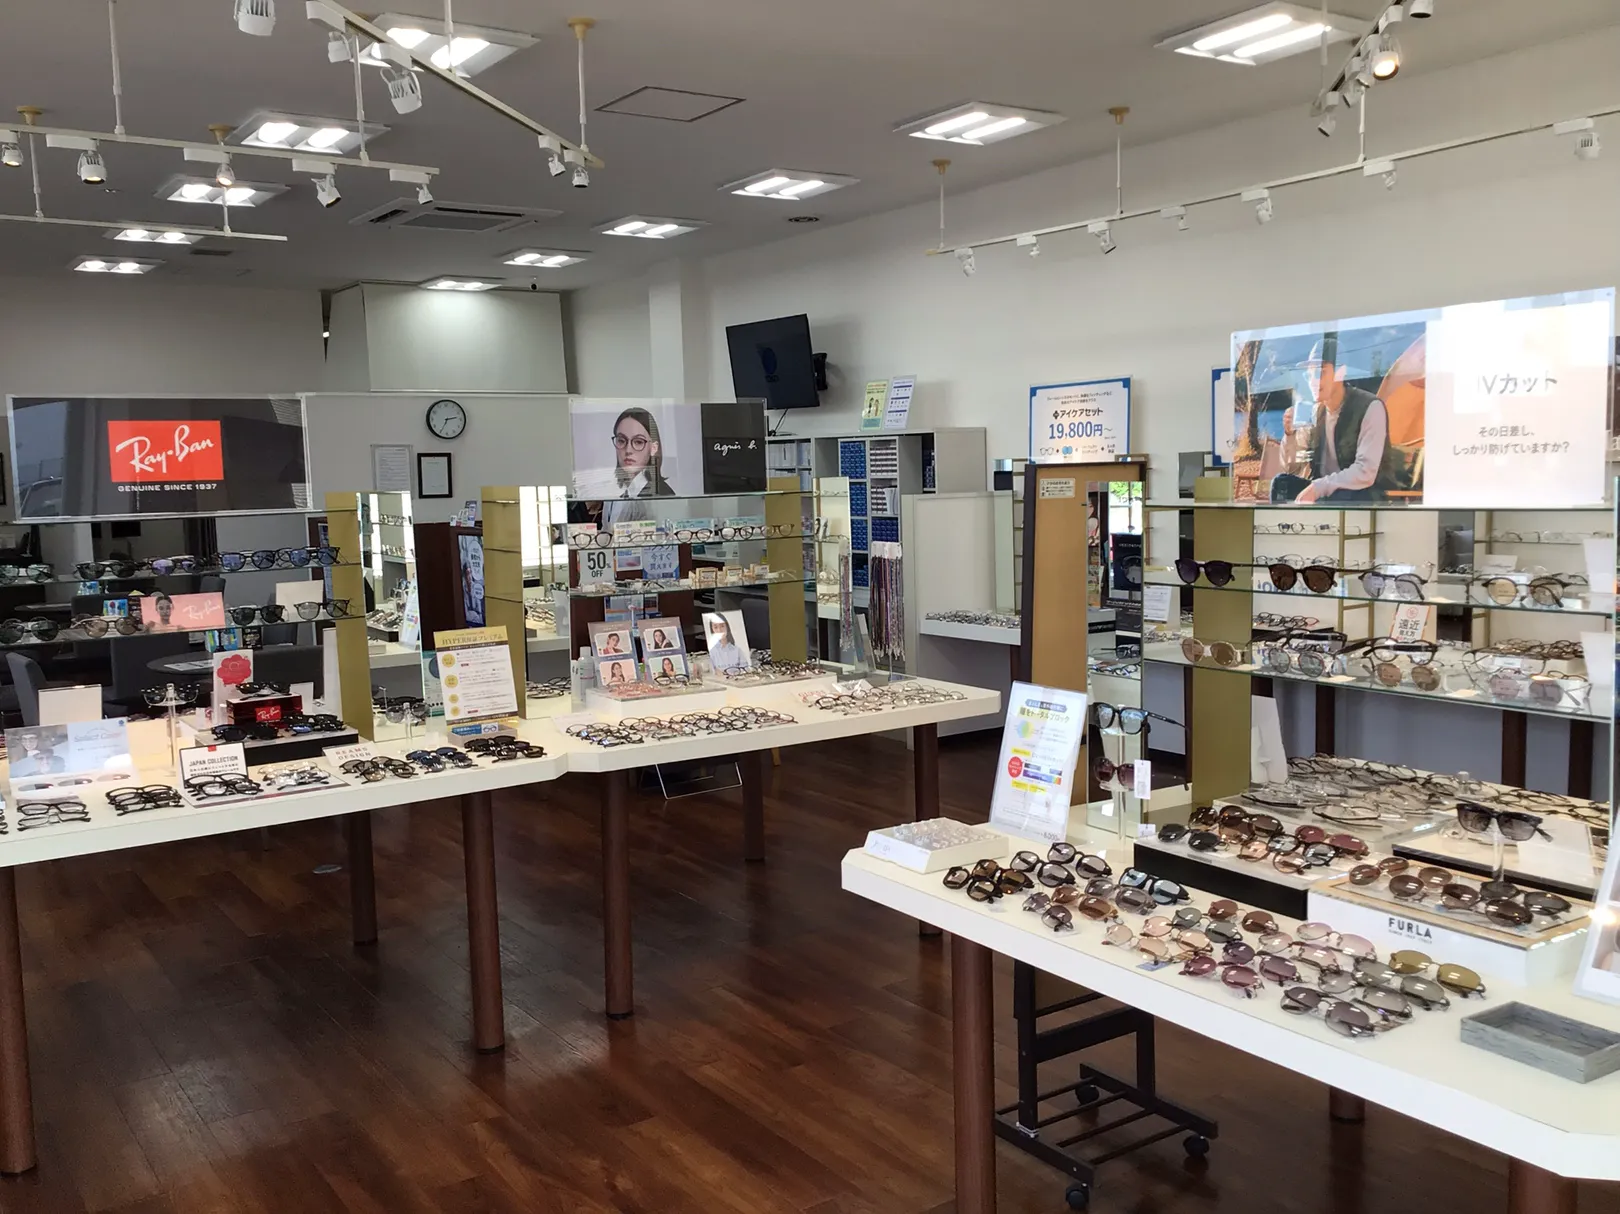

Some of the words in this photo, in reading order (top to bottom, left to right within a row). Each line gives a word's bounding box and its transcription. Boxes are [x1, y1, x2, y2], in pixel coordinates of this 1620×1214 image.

[1473, 370, 1558, 395] Vカット
[1059, 407, 1104, 419] アイケアセット
[115, 424, 215, 473] Ray-Ban
[591, 570, 603, 578] OFF
[207, 756, 238, 765] COLLECTION
[338, 752, 371, 760] DESIGN
[1388, 917, 1433, 939] FURLA
